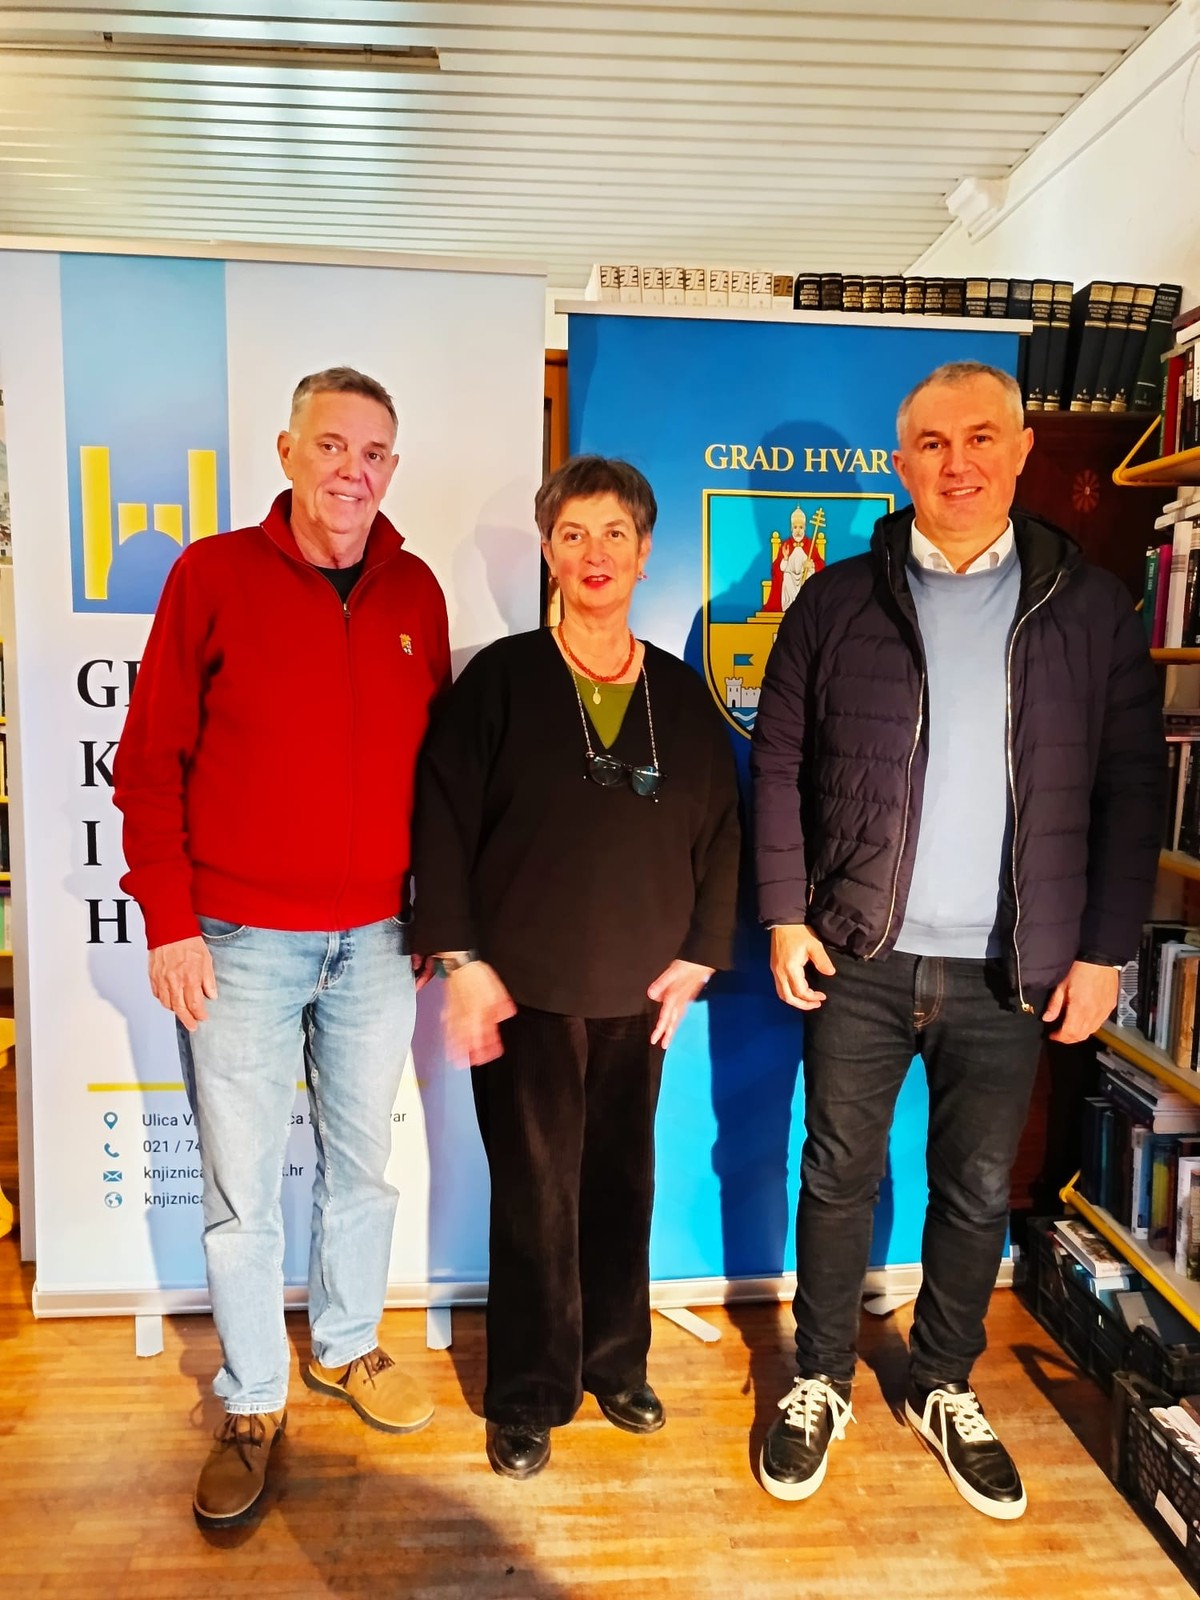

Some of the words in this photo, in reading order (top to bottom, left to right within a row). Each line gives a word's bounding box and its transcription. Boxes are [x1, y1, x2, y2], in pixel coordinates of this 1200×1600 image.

[704, 443, 794, 472] GRAD
[804, 448, 891, 475] HVAR
[81, 820, 102, 866] I
[142, 1113, 178, 1126] Ulica
[143, 1140, 169, 1153] 021
